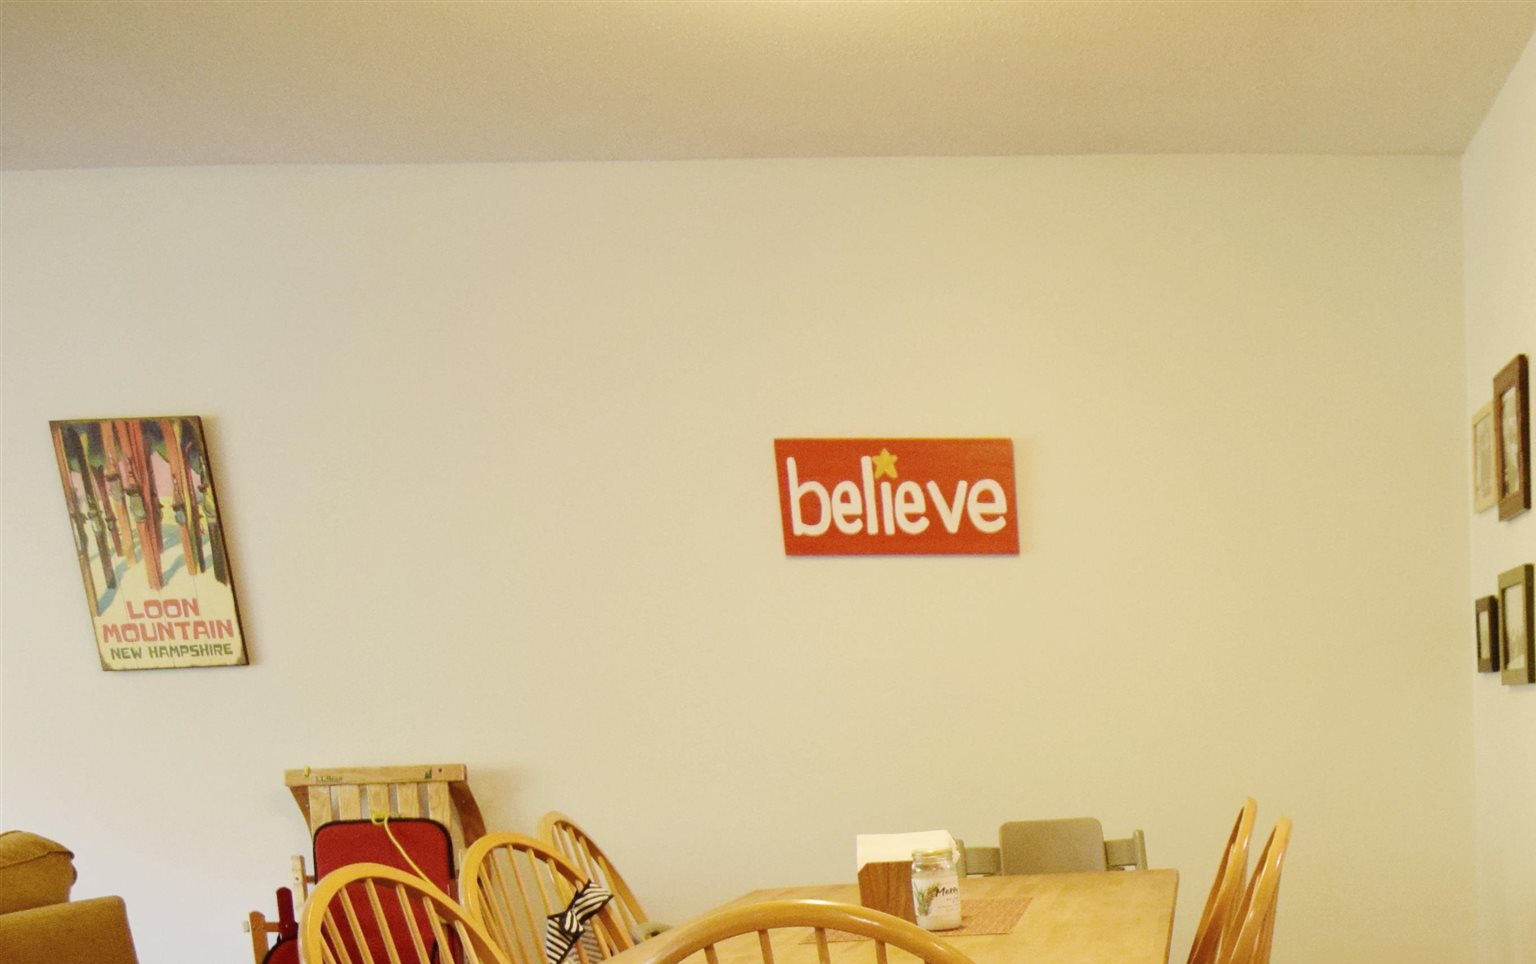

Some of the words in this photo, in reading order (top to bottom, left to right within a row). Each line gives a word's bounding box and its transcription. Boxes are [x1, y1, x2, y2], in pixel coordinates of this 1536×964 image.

[786, 455, 1008, 537] believe
[126, 598, 200, 619] LOON
[102, 620, 234, 643] MOUNTAIN
[110, 646, 142, 660] NEW
[149, 643, 233, 659] HAMPSHIRE
